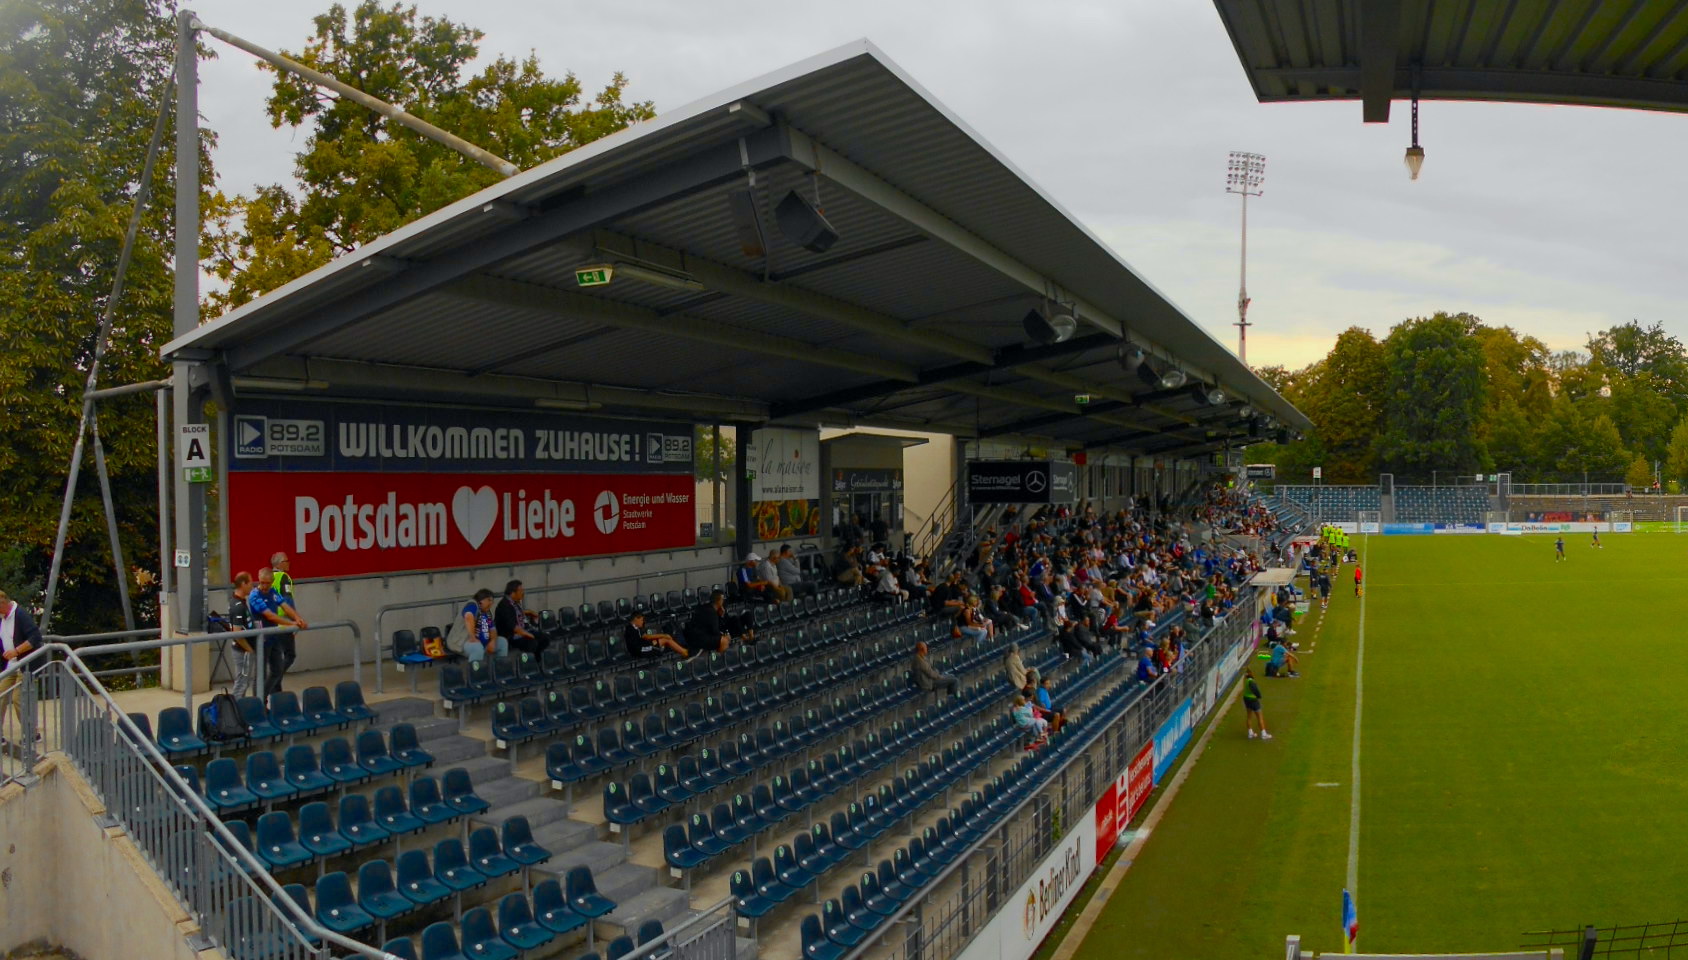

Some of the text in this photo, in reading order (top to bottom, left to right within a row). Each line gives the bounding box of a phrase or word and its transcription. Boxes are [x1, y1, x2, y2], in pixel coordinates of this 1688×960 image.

[182, 426, 207, 434] BLOCK
[270, 424, 320, 442] 89.2
[339, 422, 525, 459] WILLKOMMEN
[664, 439, 690, 452] 89.2
[186, 438, 205, 461] A
[239, 446, 264, 454] RADIO
[270, 444, 320, 453] POTSDAM
[971, 474, 1021, 486] Sternagel
[622, 492, 690, 507] Energie und Wasser
[622, 509, 652, 518] Stadtwerke
[295, 488, 576, 553] Potsdam Liebe
[622, 520, 646, 530] Potsdam
[1039, 836, 1081, 923] Berliner Kindl
